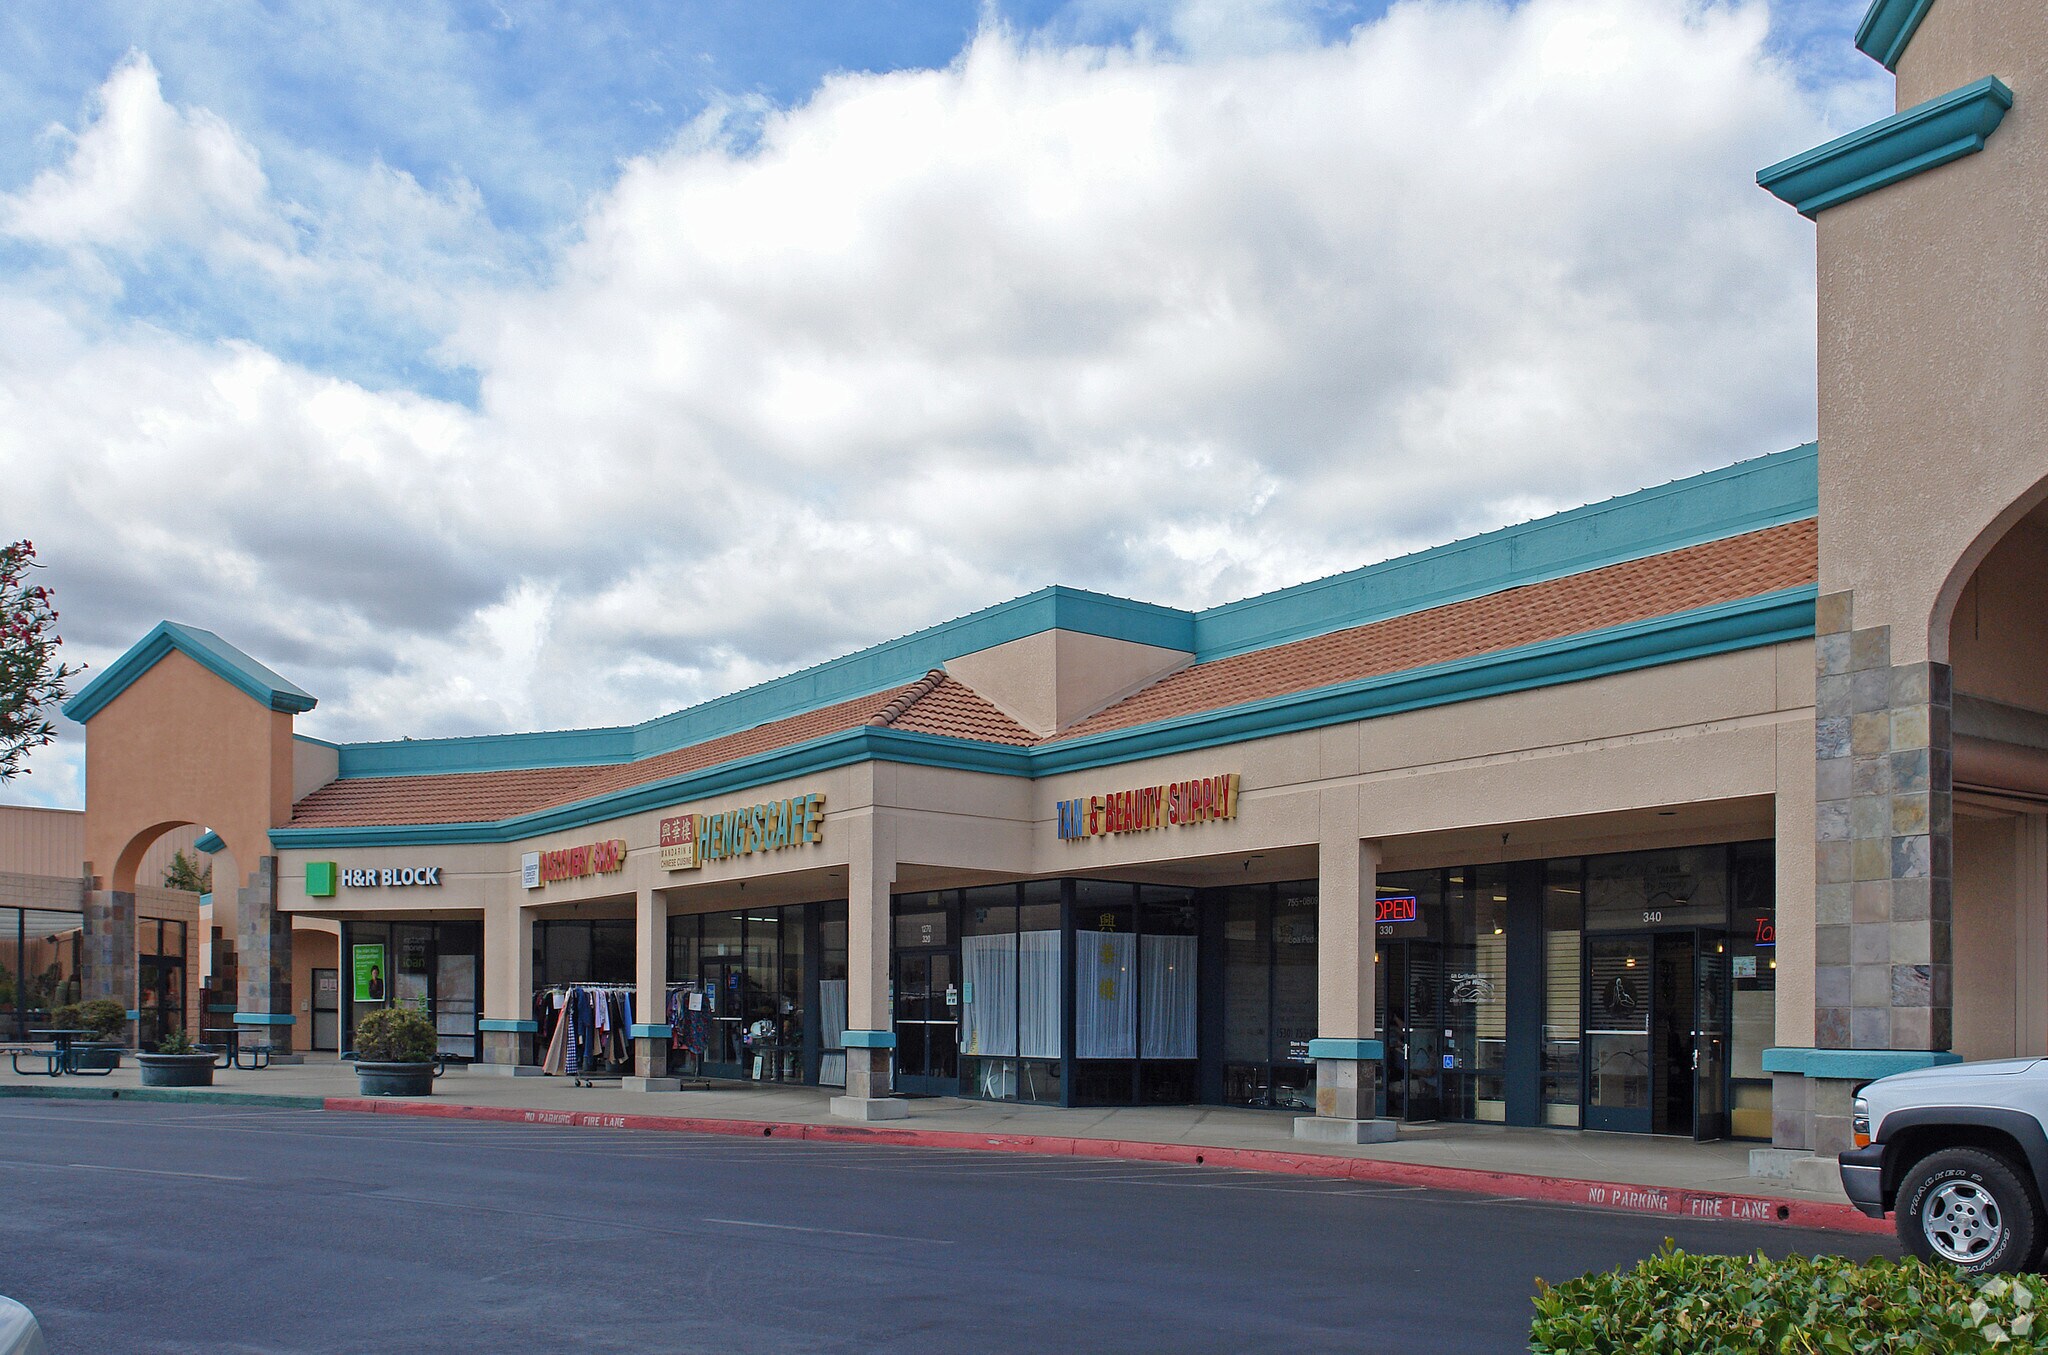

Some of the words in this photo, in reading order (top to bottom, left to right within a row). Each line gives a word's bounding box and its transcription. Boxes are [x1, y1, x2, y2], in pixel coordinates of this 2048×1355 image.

[1056, 798, 1083, 840] TAN
[1089, 795, 1099, 836] &
[1105, 785, 1164, 833] BEAUTY
[1168, 773, 1233, 825] SUPPLY
[541, 845, 590, 882] DISCOVERY
[593, 839, 620, 873] SHOP
[660, 847, 687, 858] MANDARIN
[660, 858, 677, 868] CHINESE
[676, 856, 692, 867] CUISINE
[341, 869, 378, 887] H&R
[381, 867, 440, 886] BLOCK
[1375, 898, 1415, 921] OPEN
[1642, 911, 1662, 923] 340
[1379, 925, 1394, 935] 330
[1755, 918, 1776, 942] Ta
[525, 1112, 535, 1121] NO
[538, 1113, 571, 1124] PARKING
[583, 1116, 601, 1126] FIRE
[603, 1117, 625, 1127] LANE
[1909, 1169, 1967, 1216] TRACKER
[1588, 1187, 1605, 1204] NO
[1611, 1189, 1668, 1211] PARKING
[1691, 1198, 1723, 1217] FIRE
[1731, 1200, 1771, 1220] LANE
